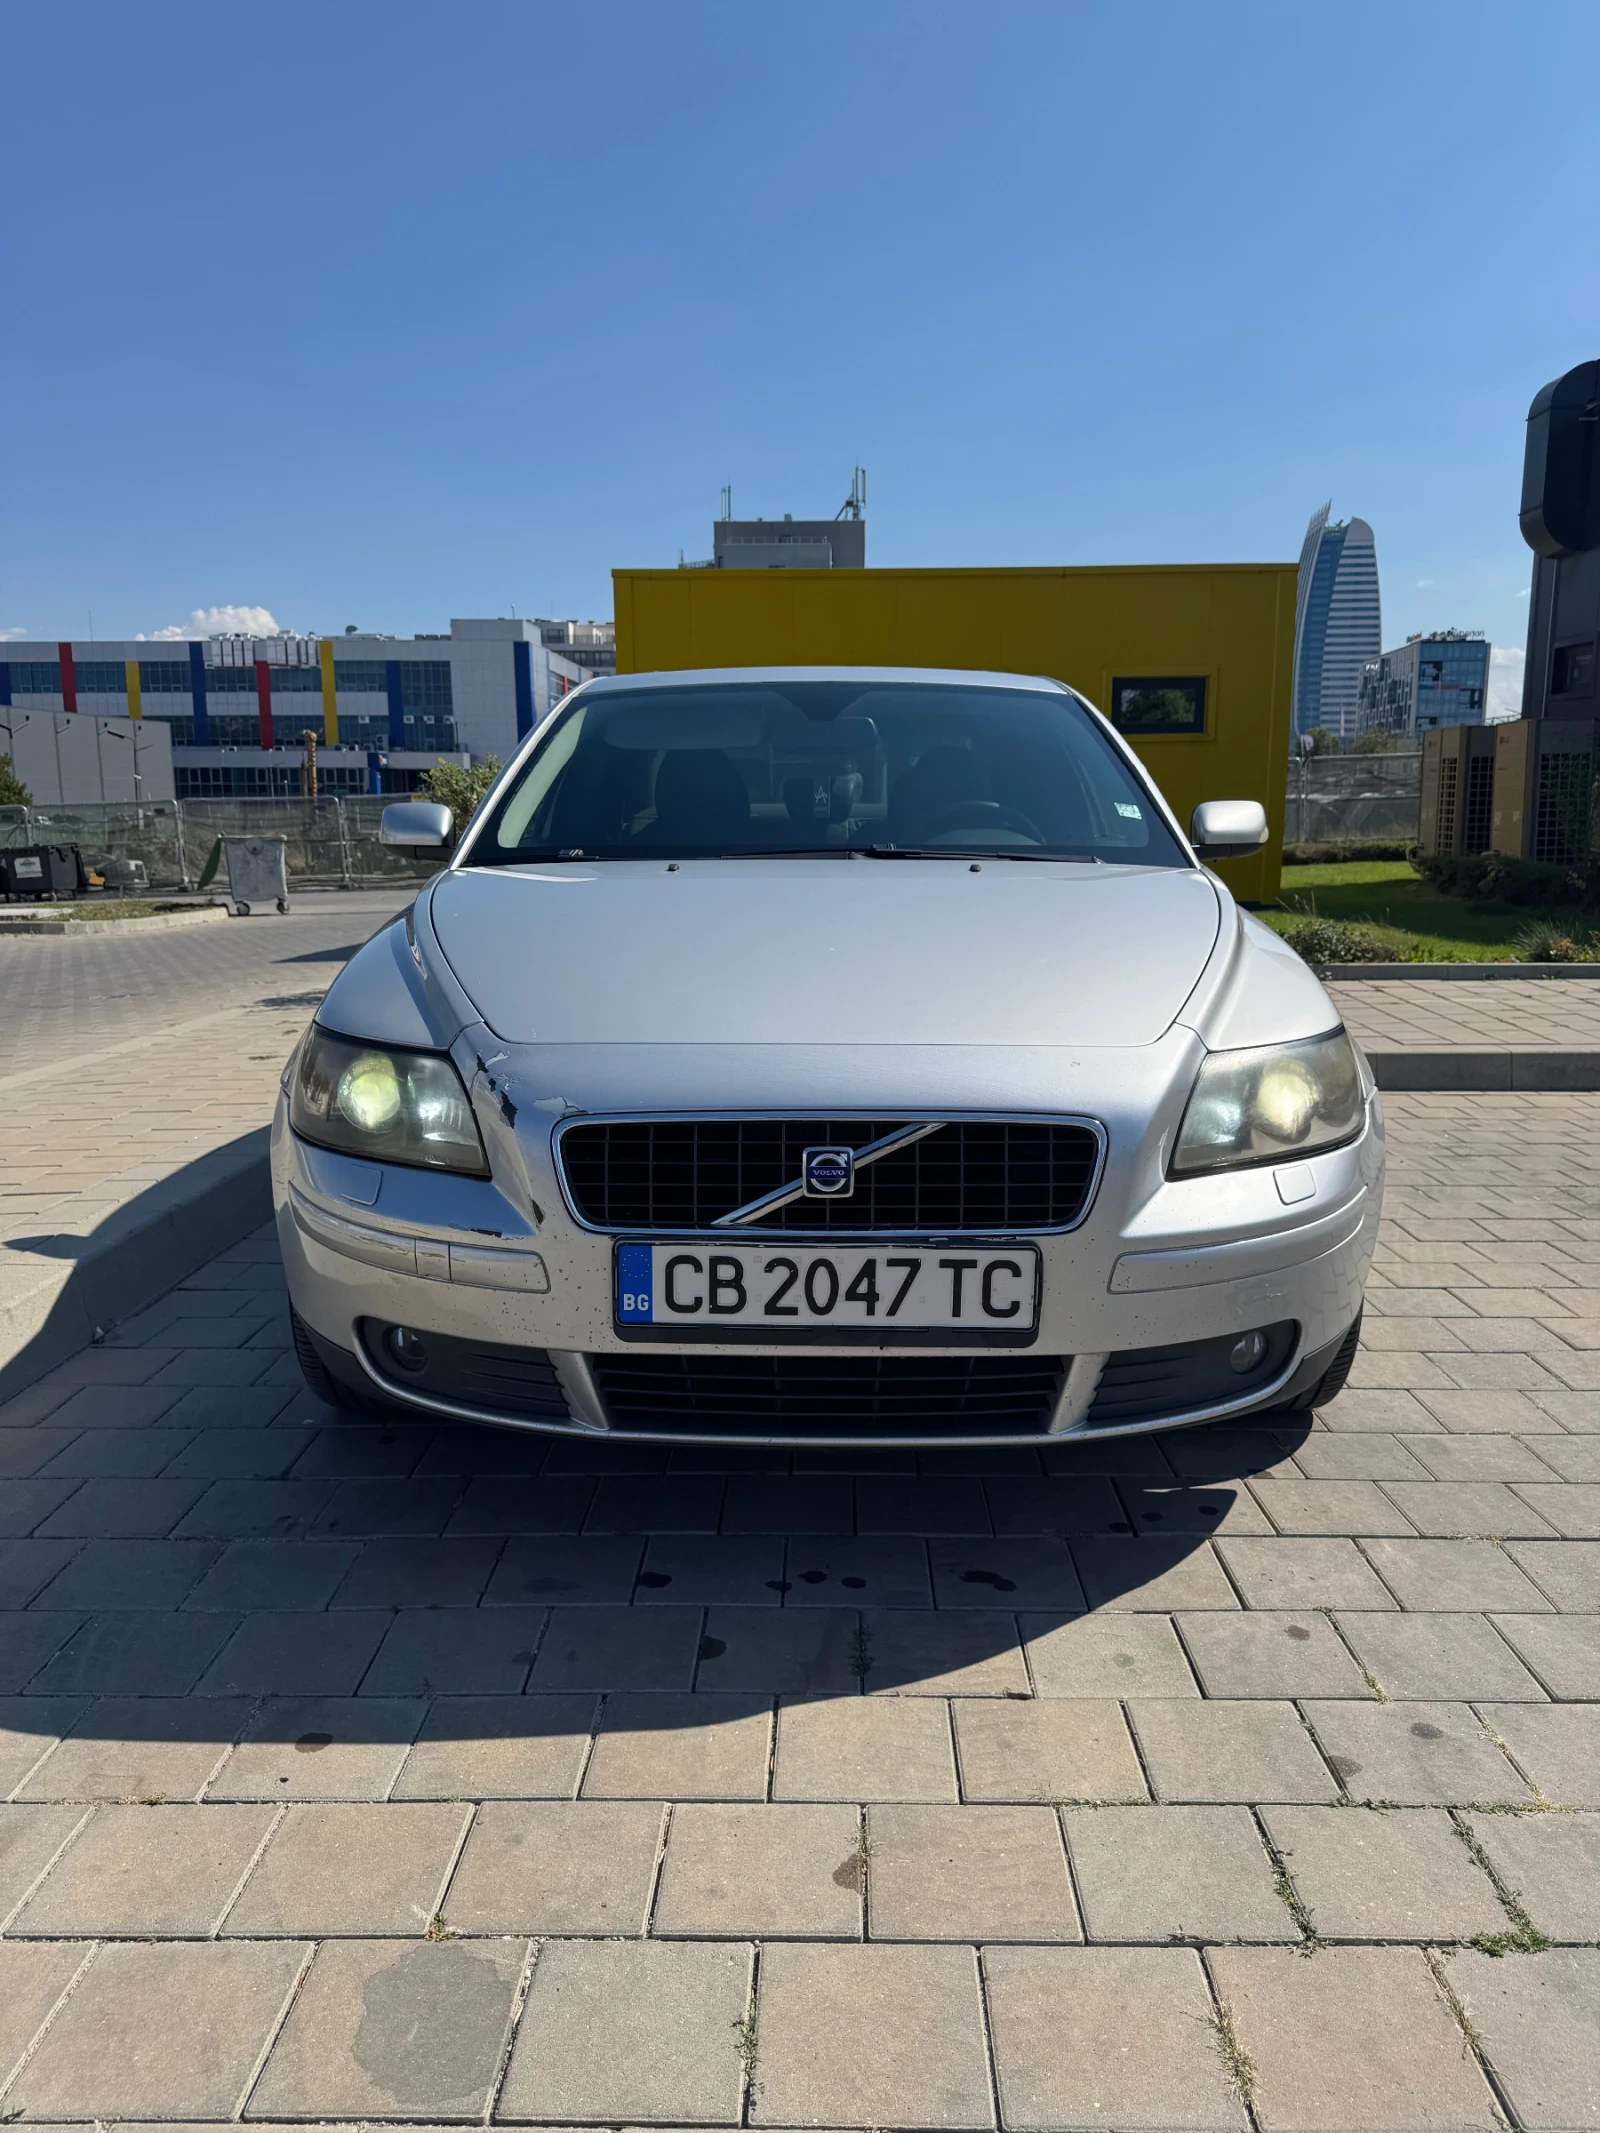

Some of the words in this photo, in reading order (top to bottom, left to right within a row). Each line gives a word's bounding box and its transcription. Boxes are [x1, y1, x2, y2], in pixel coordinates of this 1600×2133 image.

[622, 1293, 649, 1311] BG
[664, 1254, 748, 1314] CB
[763, 1257, 923, 1316] 2047
[939, 1258, 1022, 1318] TC
